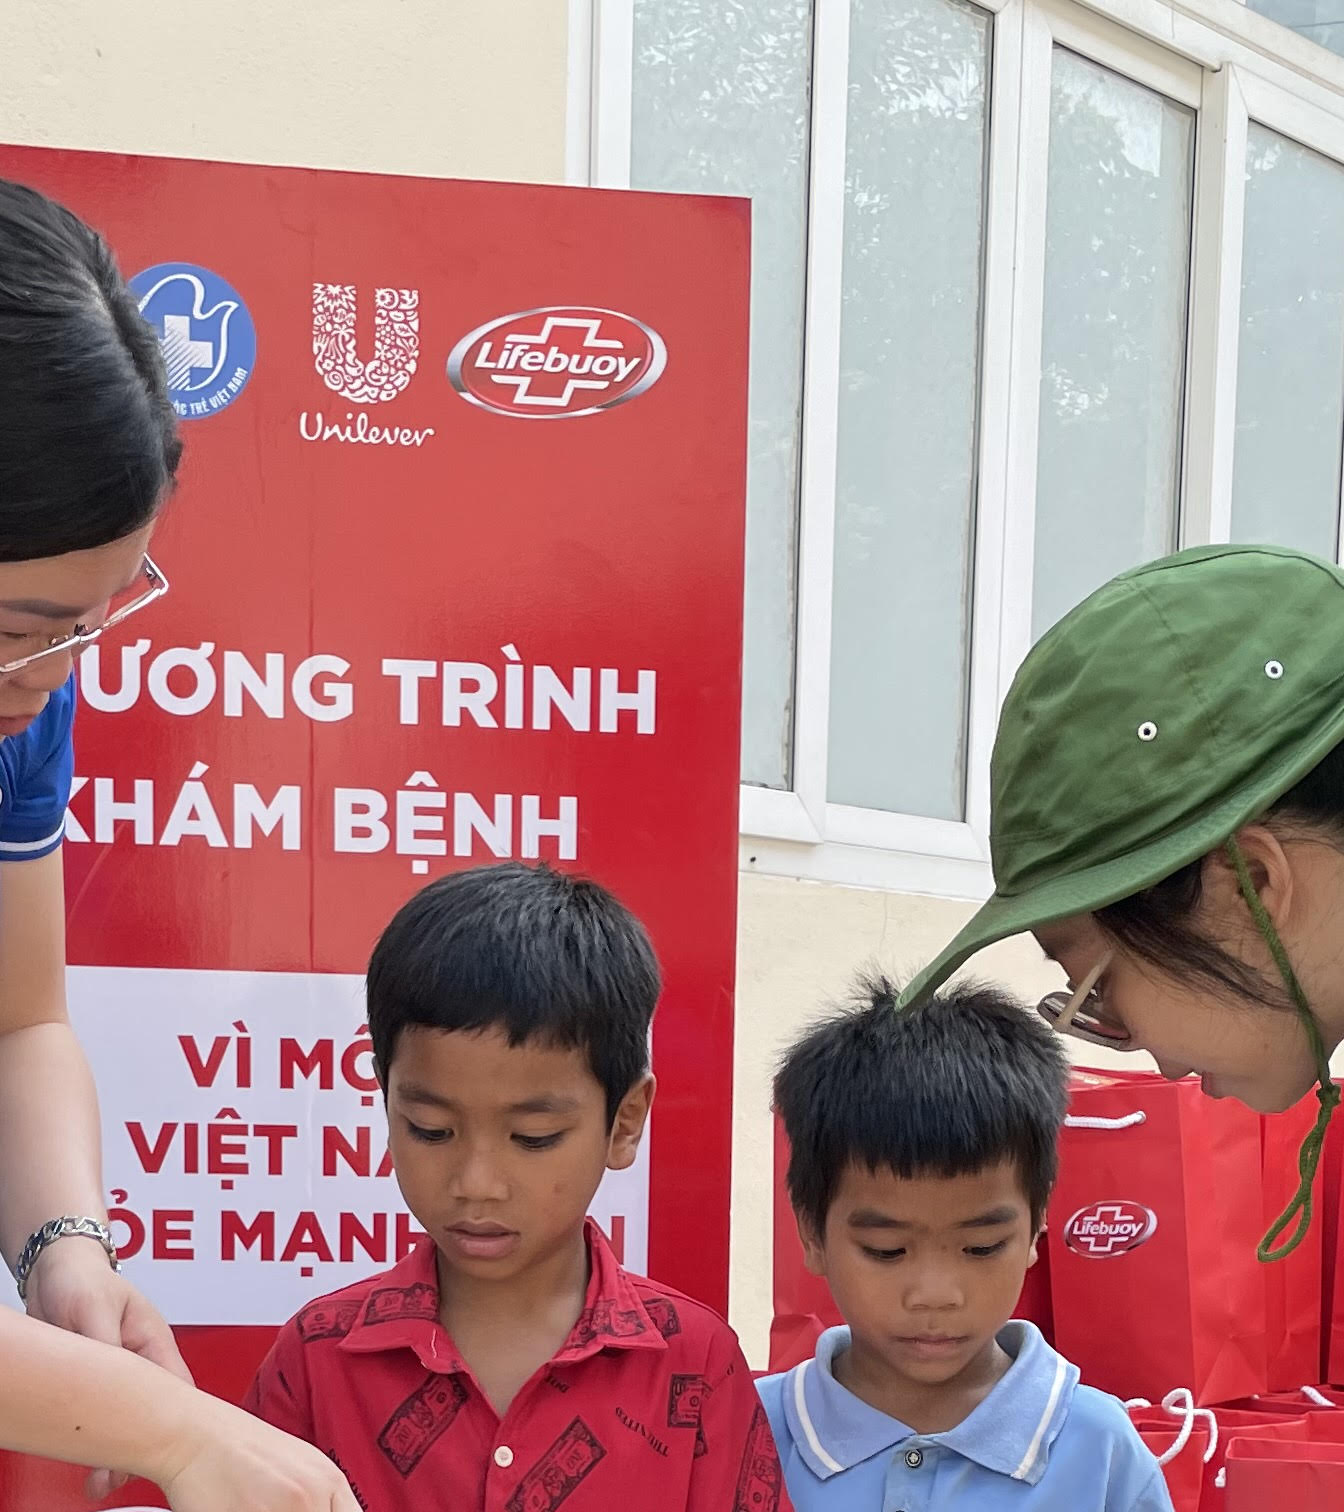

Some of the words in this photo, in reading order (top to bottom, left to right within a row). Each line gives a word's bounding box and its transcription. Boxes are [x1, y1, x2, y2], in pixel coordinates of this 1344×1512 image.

[229, 366, 249, 394] NAM
[474, 341, 642, 383] Lifebuoy
[299, 412, 435, 447] Unilever
[79, 638, 354, 723] ƯƠNG
[382, 643, 657, 735] TRÌNH
[334, 771, 578, 874] BỆNH
[177, 1019, 251, 1088] VÌ
[280, 1023, 382, 1107] MỘ
[125, 1107, 298, 1190] VIỆT
[1072, 1219, 1144, 1239] Lifebuoy
